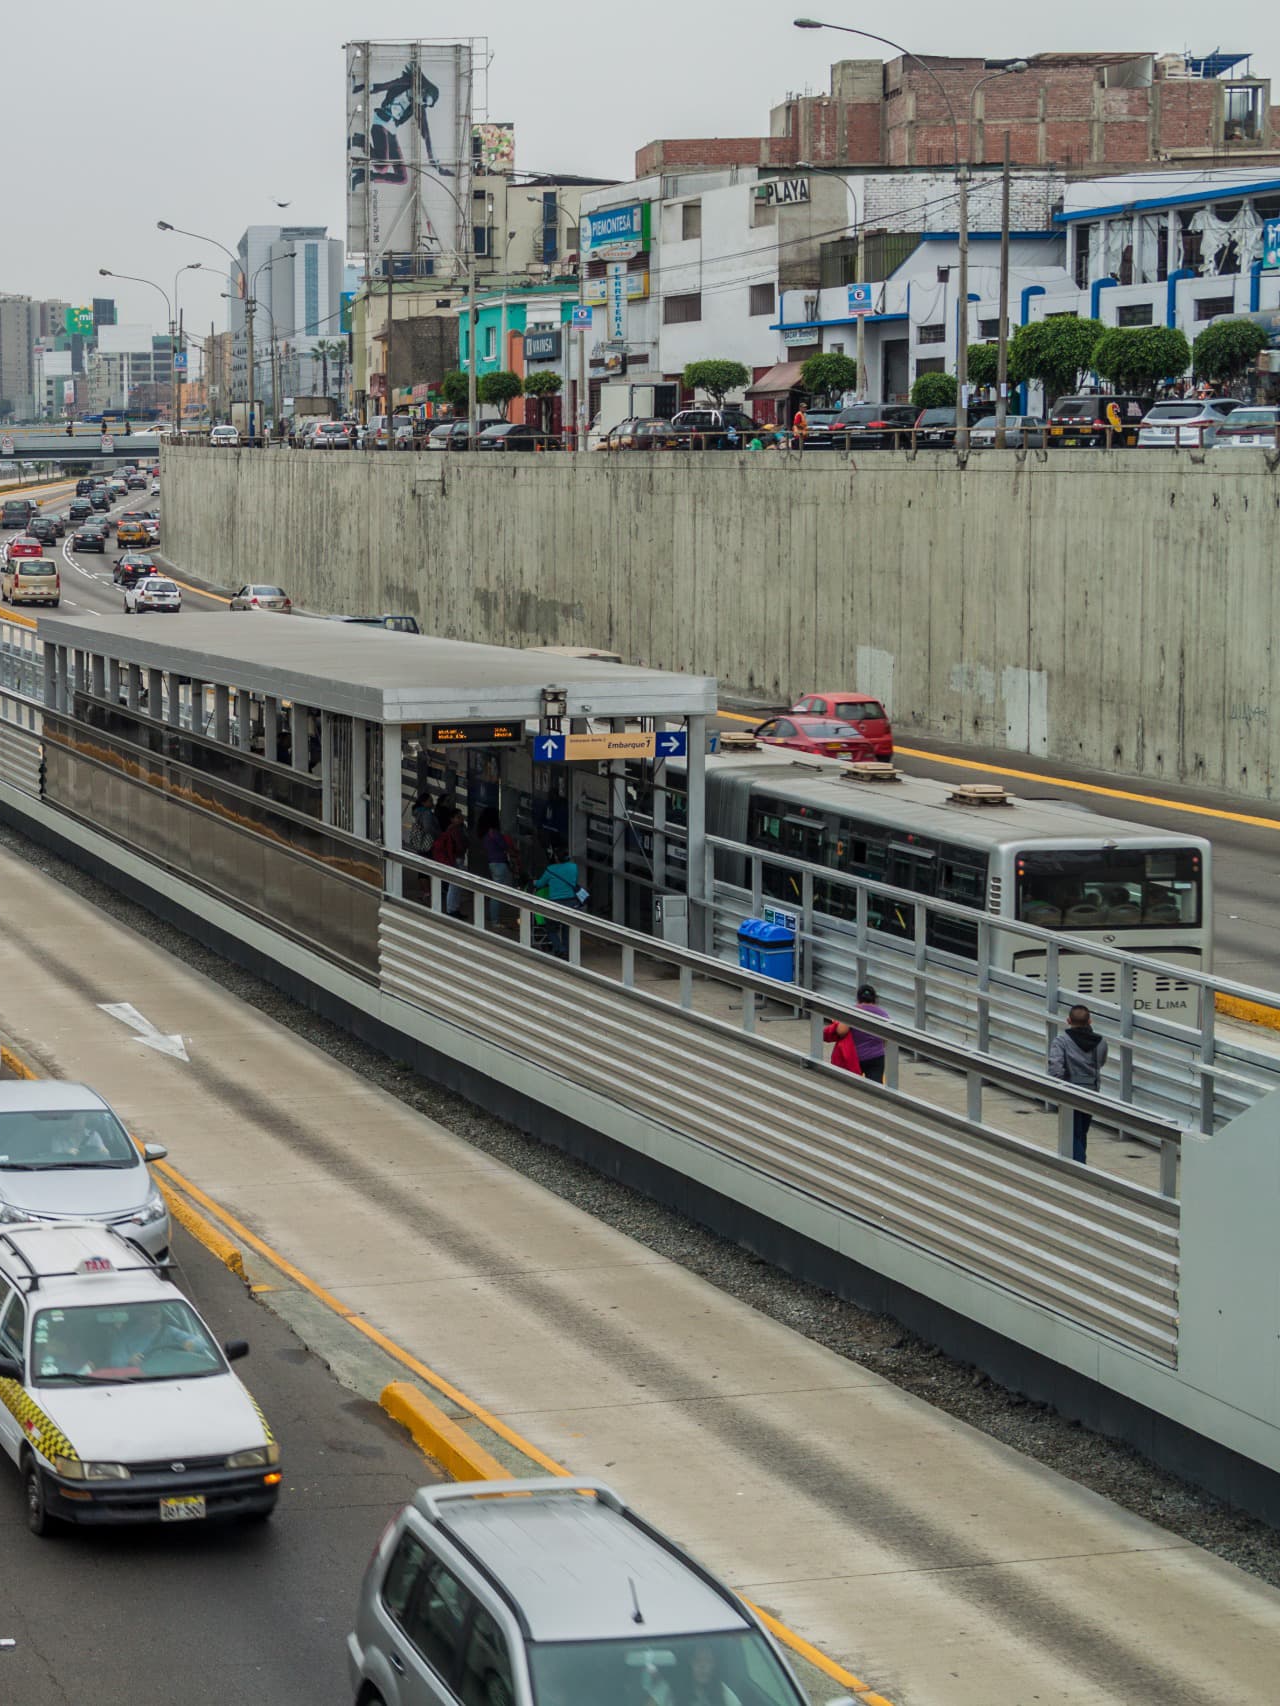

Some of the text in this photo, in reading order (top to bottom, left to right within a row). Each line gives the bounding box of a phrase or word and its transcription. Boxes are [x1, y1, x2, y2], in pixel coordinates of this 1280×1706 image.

[767, 179, 809, 205] PLAYA
[592, 215, 632, 236] PIEMONTESA
[532, 337, 553, 353] VAINSA
[607, 739, 645, 750] Embarque
[645, 739, 651, 748] 1
[708, 737, 718, 753] 1
[84, 1260, 111, 1271] TAXI
